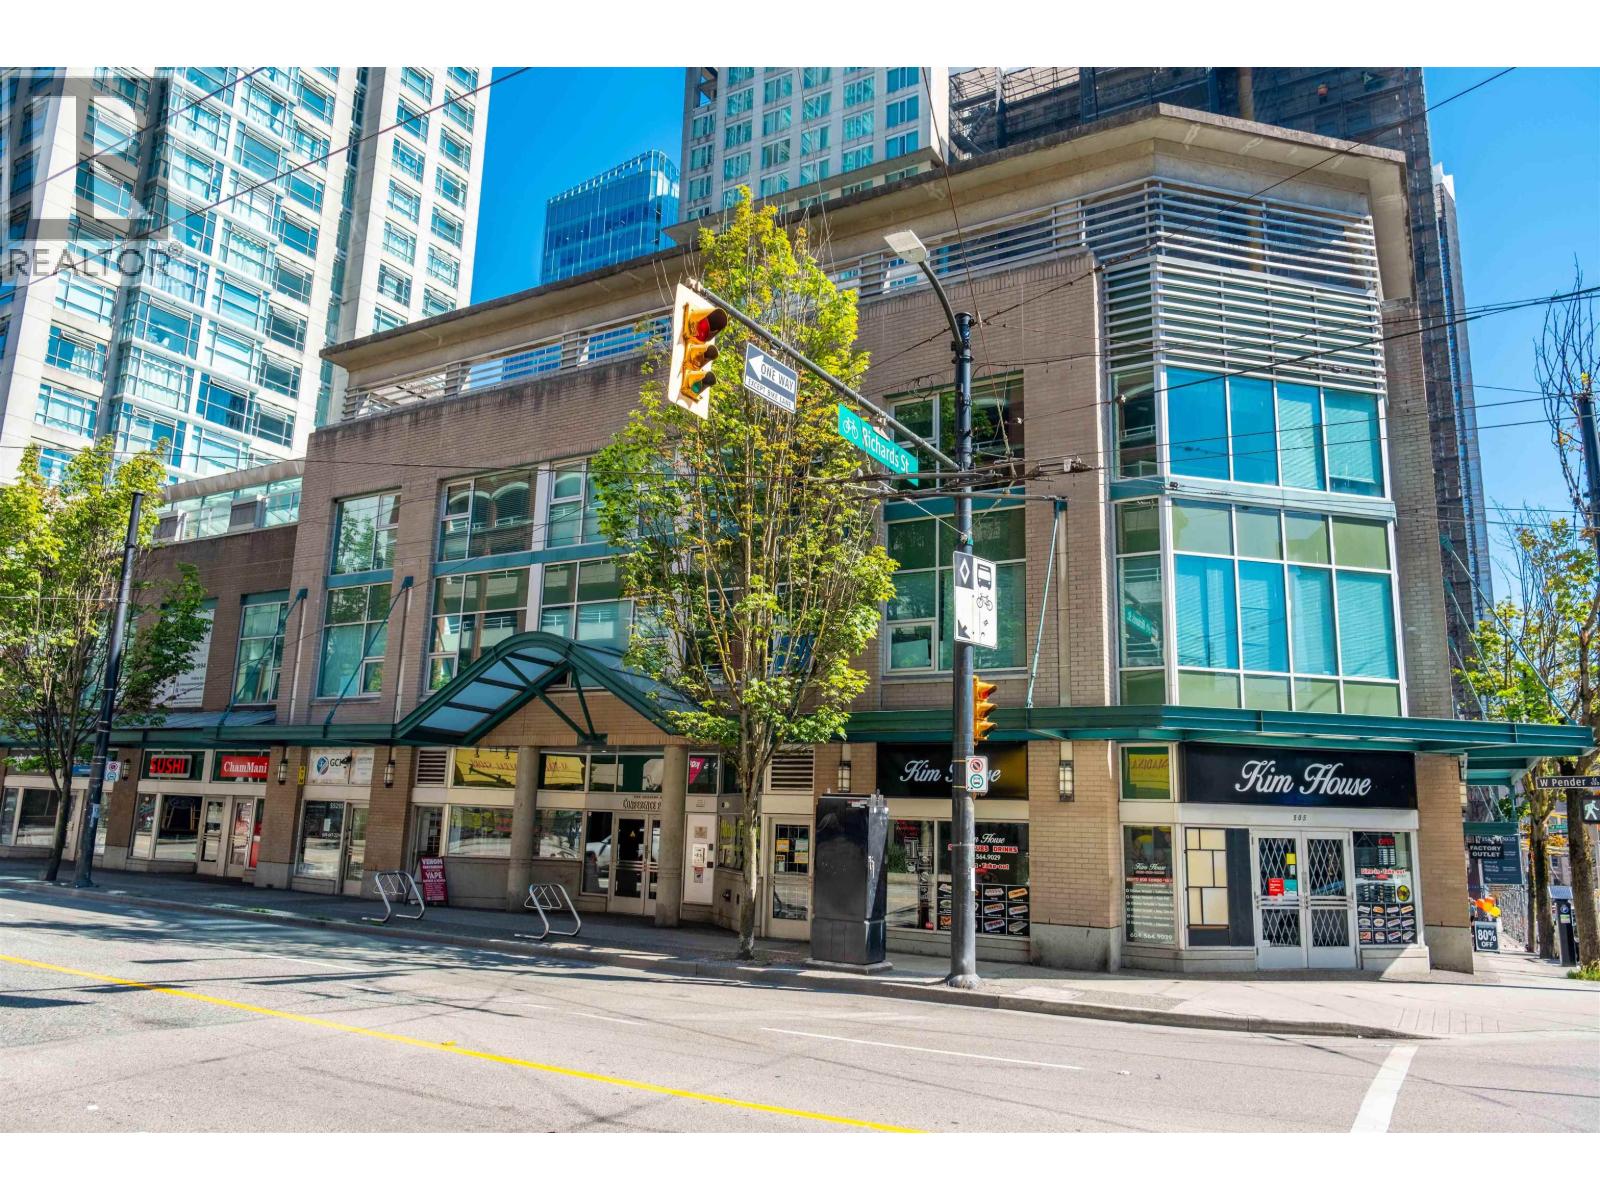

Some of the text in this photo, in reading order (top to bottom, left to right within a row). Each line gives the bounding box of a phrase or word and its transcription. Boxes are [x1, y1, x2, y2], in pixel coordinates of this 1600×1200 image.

[761, 363, 794, 391] ONE WAY
[748, 378, 791, 408] EXCEPT BIKE LANE
[862, 427, 910, 474] Richards St
[149, 757, 186, 774] SUSHI
[223, 761, 268, 773] ChamMani
[900, 759, 942, 782] Kim
[1234, 760, 1372, 796] Kim House
[1540, 778, 1548, 787] W
[1551, 777, 1586, 787] Pender
[980, 833, 1006, 844] House
[425, 871, 443, 879] VAPE
[1477, 928, 1497, 942] 80%
